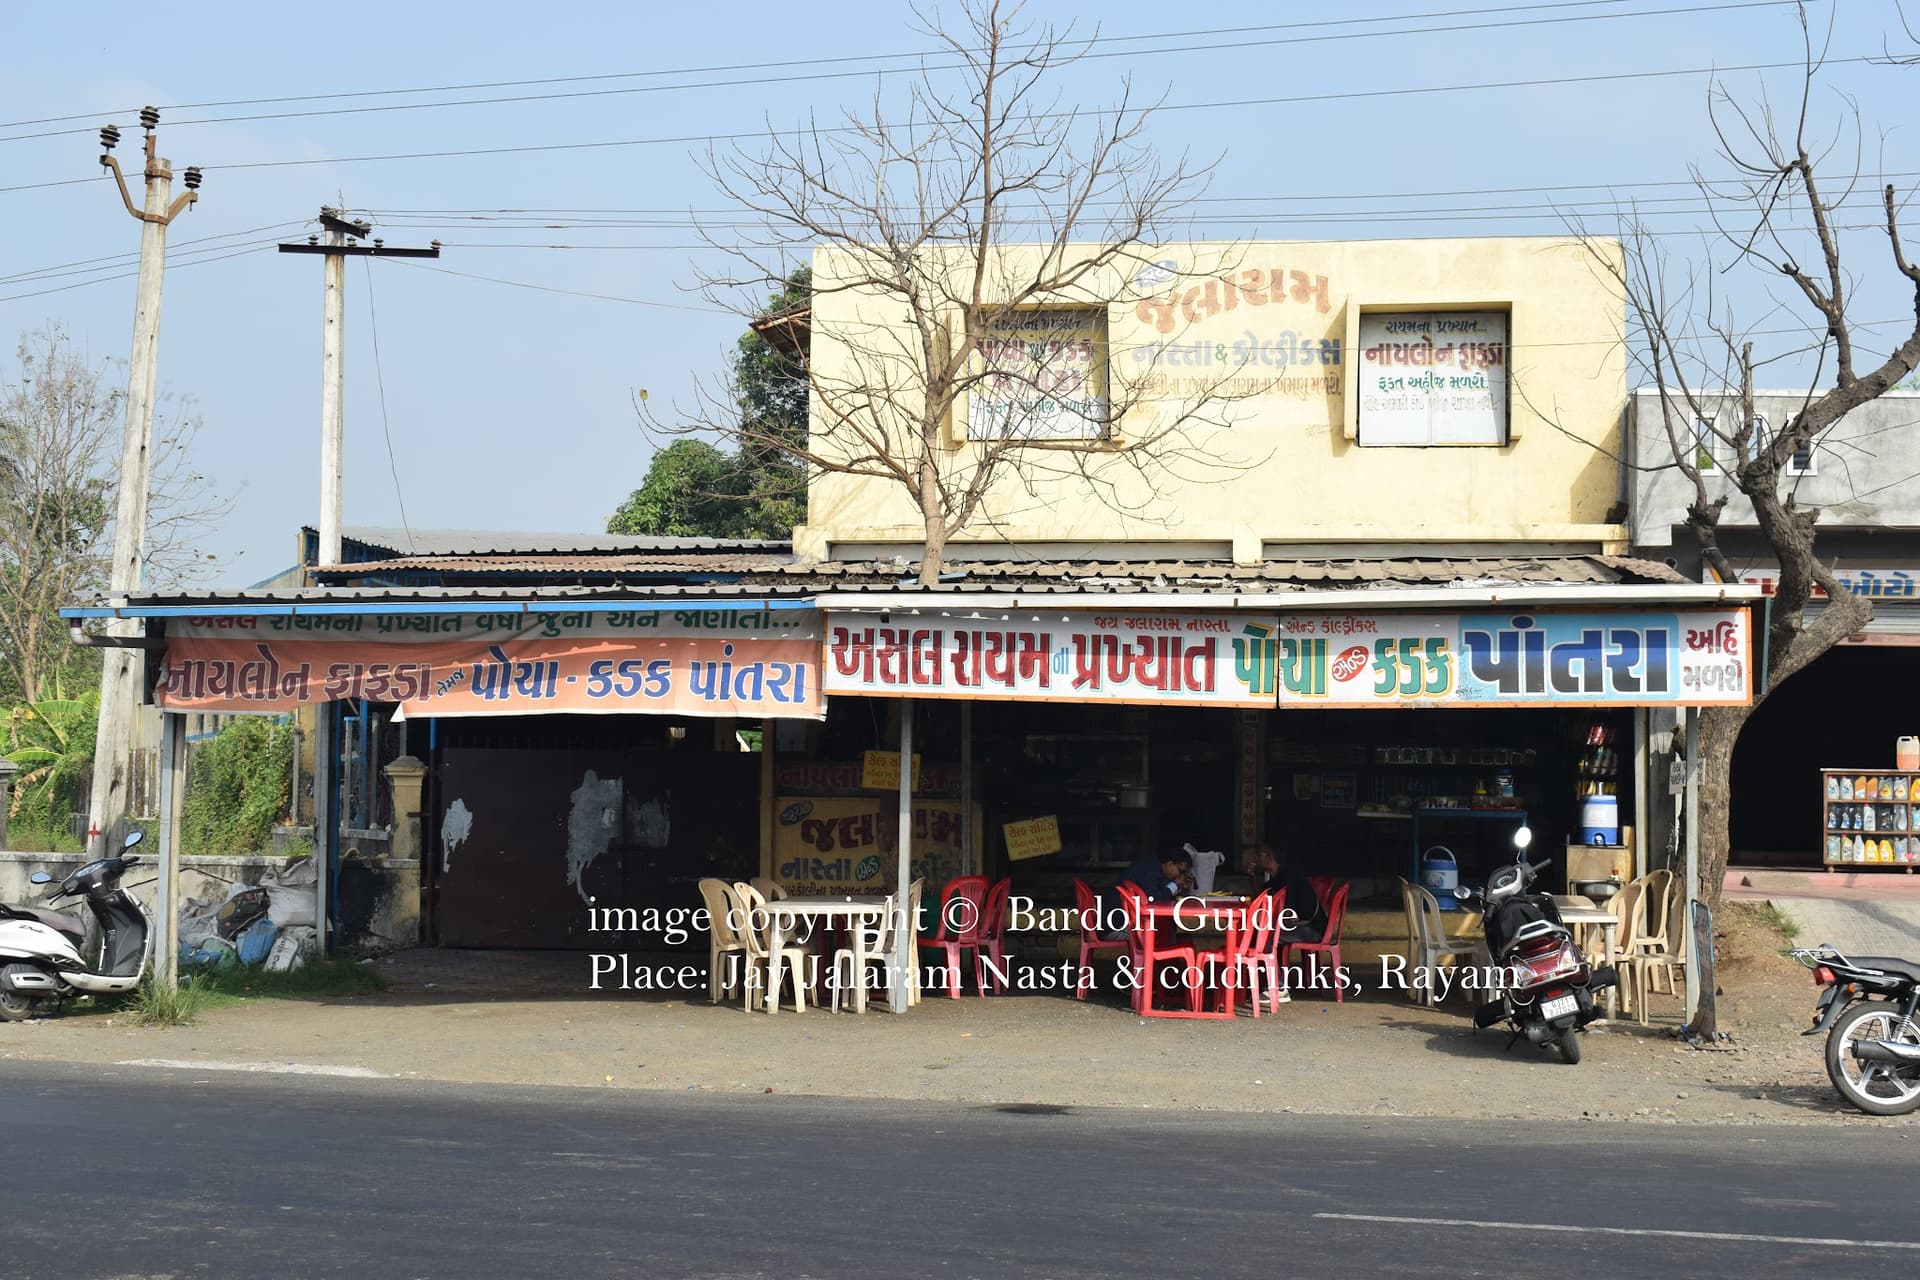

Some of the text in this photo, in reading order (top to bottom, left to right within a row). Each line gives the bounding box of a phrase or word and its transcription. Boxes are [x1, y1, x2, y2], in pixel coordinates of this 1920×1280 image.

[1215, 343, 1228, 365] &
[1122, 617, 1182, 632] જલારામ
[1186, 619, 1230, 633] નાસ્તા
[166, 642, 312, 701] નાયલોન
[323, 661, 432, 703] ફાફડા
[470, 645, 560, 700] પોચા
[585, 658, 673, 699] કડક
[688, 642, 807, 704] પાંતરા
[832, 627, 946, 687] અસલ
[1072, 634, 1218, 694] પ્રખ્યાત
[1373, 637, 1453, 698] કડક
[1462, 614, 1673, 697] પાંતરા
